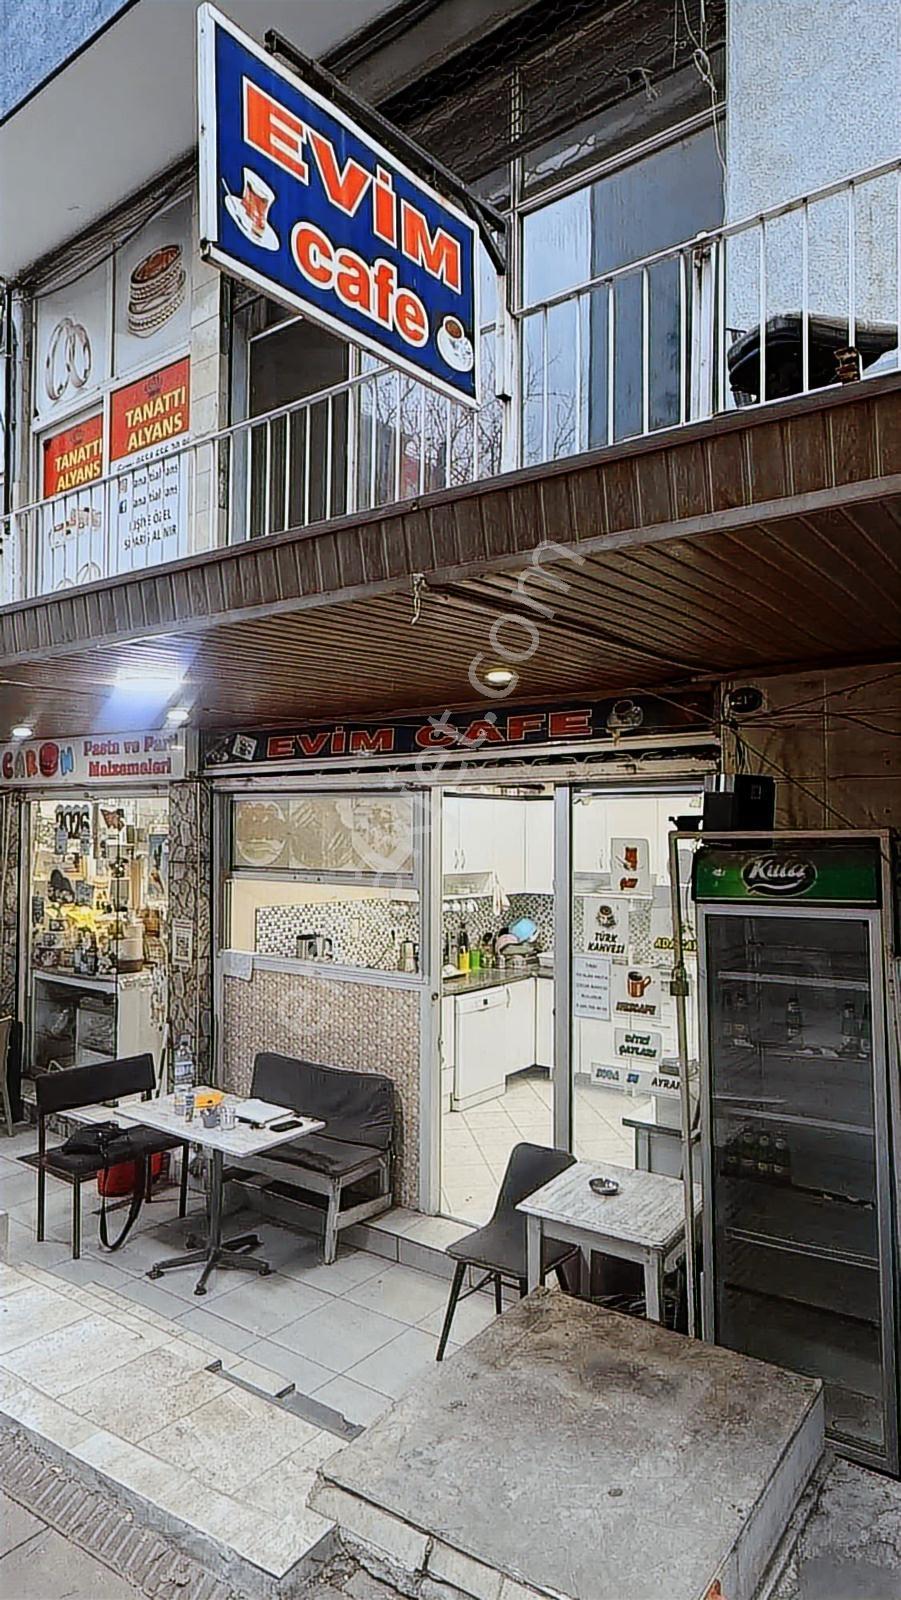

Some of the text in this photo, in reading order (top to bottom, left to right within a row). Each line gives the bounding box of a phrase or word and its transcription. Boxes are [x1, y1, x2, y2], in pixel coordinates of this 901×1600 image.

[290, 221, 429, 348] cafe
[125, 386, 185, 428] TANATTI
[127, 412, 183, 452] ALYANS
[56, 460, 100, 492] ALYANS
[415, 709, 593, 748] CAFE
